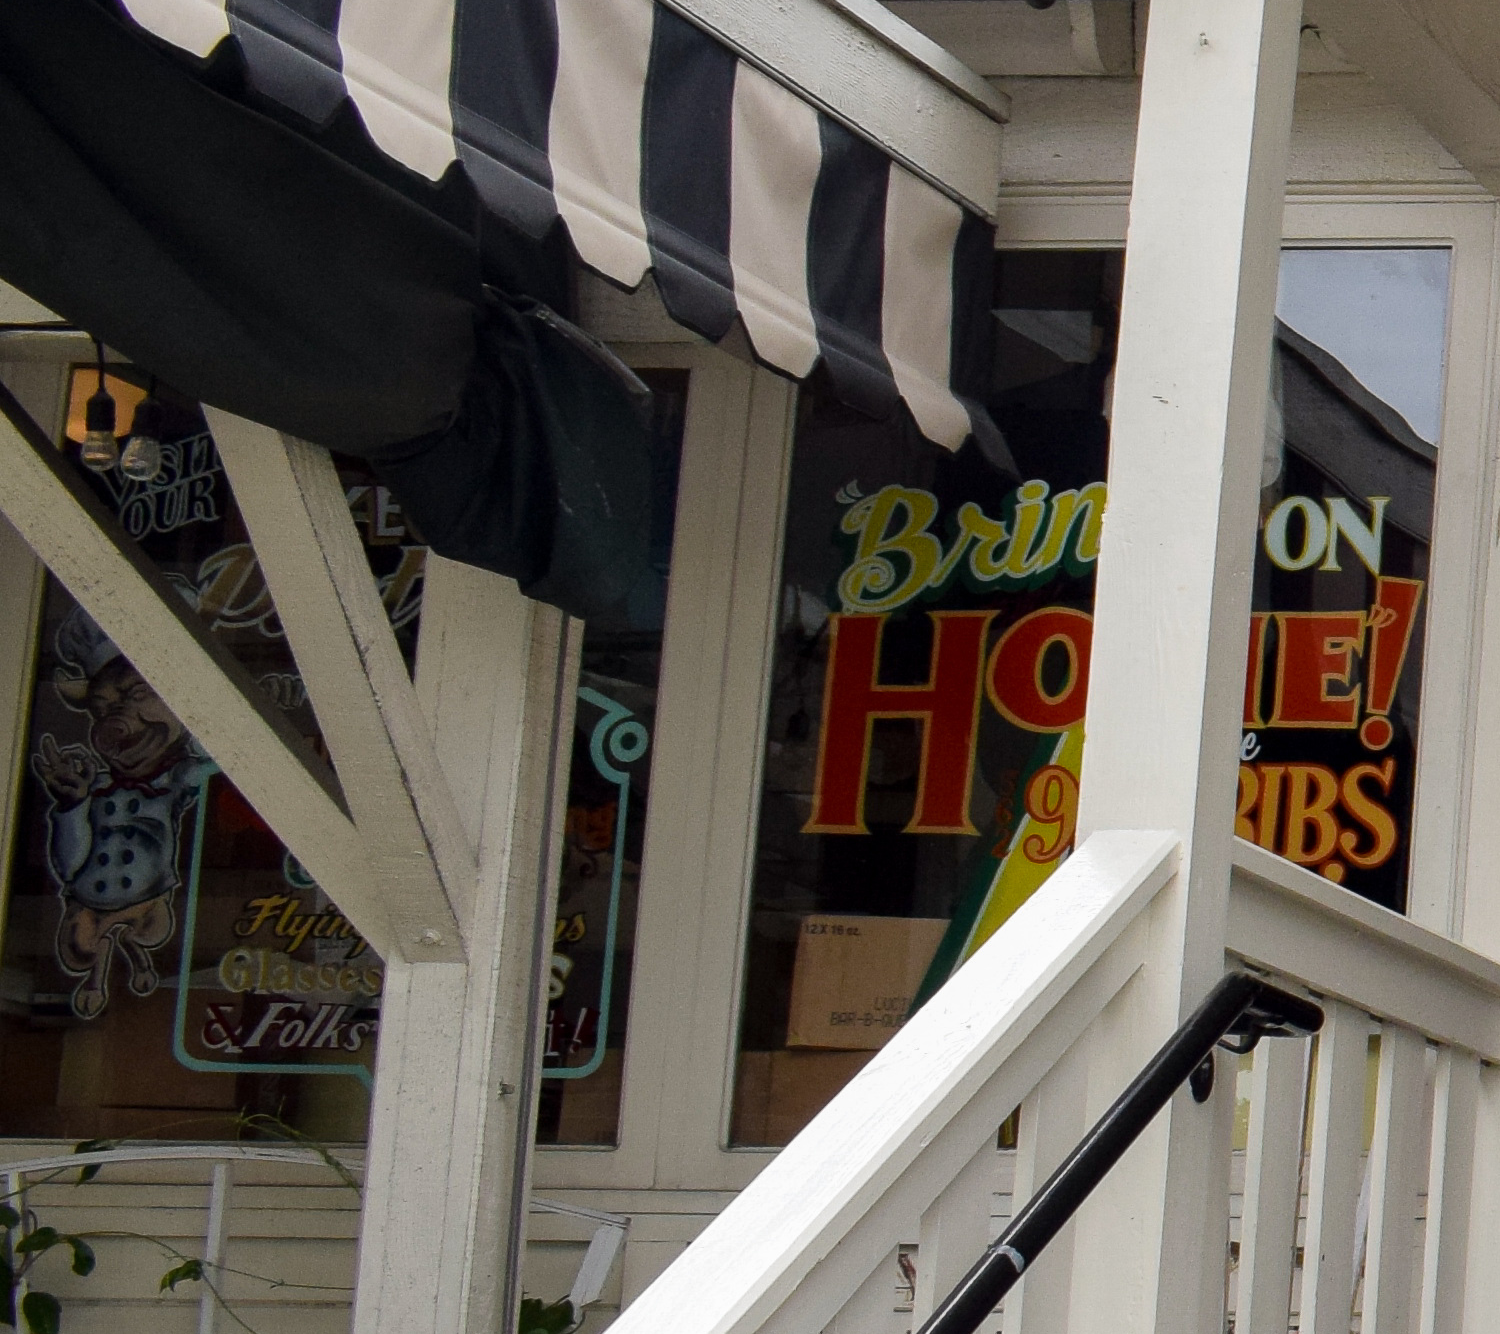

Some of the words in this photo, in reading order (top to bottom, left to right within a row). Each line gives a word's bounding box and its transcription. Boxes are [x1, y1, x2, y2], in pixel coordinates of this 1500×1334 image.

[120, 472, 221, 541] OUR
[1264, 495, 1390, 577] ON
[219, 946, 384, 997] Glasses
